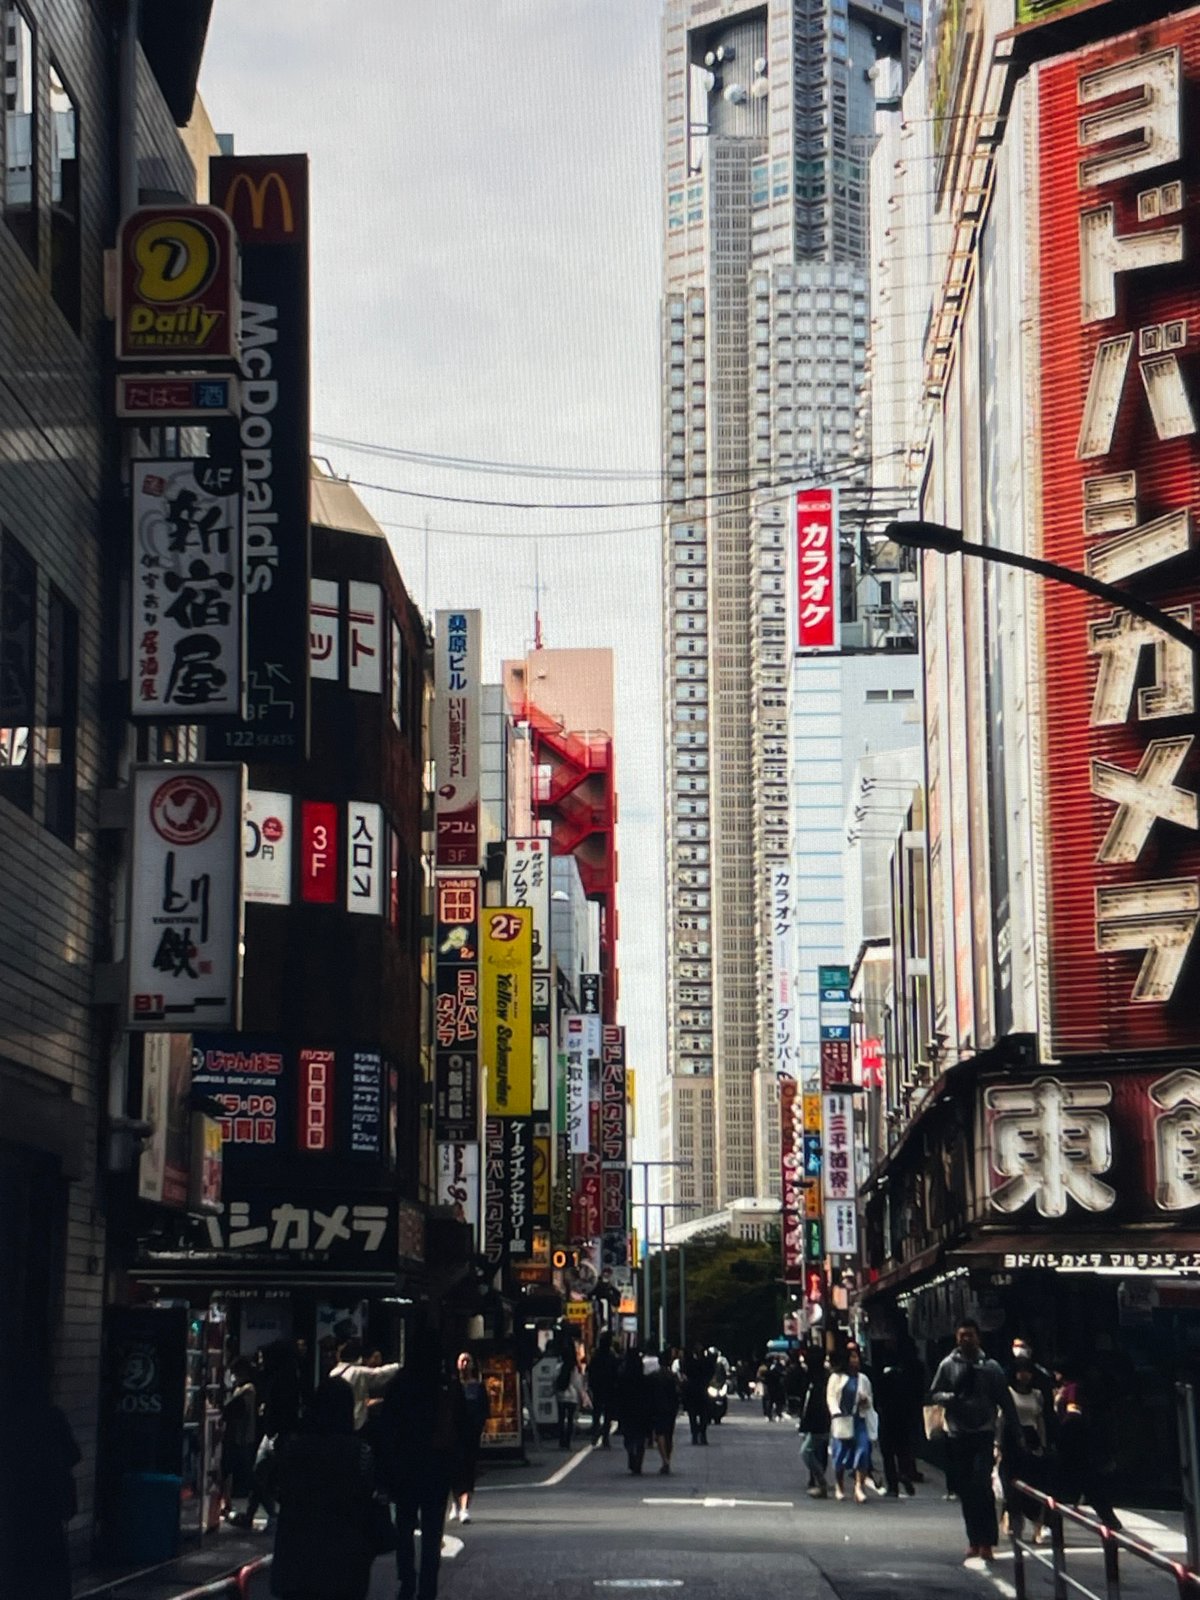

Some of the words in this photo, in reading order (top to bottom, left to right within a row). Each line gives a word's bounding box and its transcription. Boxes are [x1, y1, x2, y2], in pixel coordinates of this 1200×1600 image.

[130, 305, 221, 344] Daily
[129, 386, 190, 406] たばこ
[200, 385, 224, 406] 酒
[241, 301, 279, 594] McDonald's
[202, 467, 233, 490] 4F
[1075, 44, 1200, 1002] ヨドバシカメラ
[164, 489, 235, 706] 新宿屋
[801, 523, 830, 628] カラオケ
[448, 615, 467, 690] 桑原ビル
[224, 731, 253, 747] 122
[311, 826, 328, 877] 3F
[352, 815, 373, 868] 入口
[438, 821, 476, 834] アコム
[491, 915, 521, 939] 2F
[774, 873, 790, 936] カラオケ
[134, 994, 165, 1013] B1
[437, 993, 456, 1047] カメラ
[457, 970, 477, 1041] ヨドバシ
[497, 973, 513, 1021] Yellow
[777, 1008, 790, 1068] ダーツバー
[497, 1024, 513, 1107] Submarine
[602, 1026, 623, 1160] ヨドバシカメラ
[486, 1119, 504, 1263] ヨドバシカメラ
[510, 1120, 526, 1252] ケータイアクセサリー館
[1004, 1253, 1102, 1268] ヨドバシカメラ
